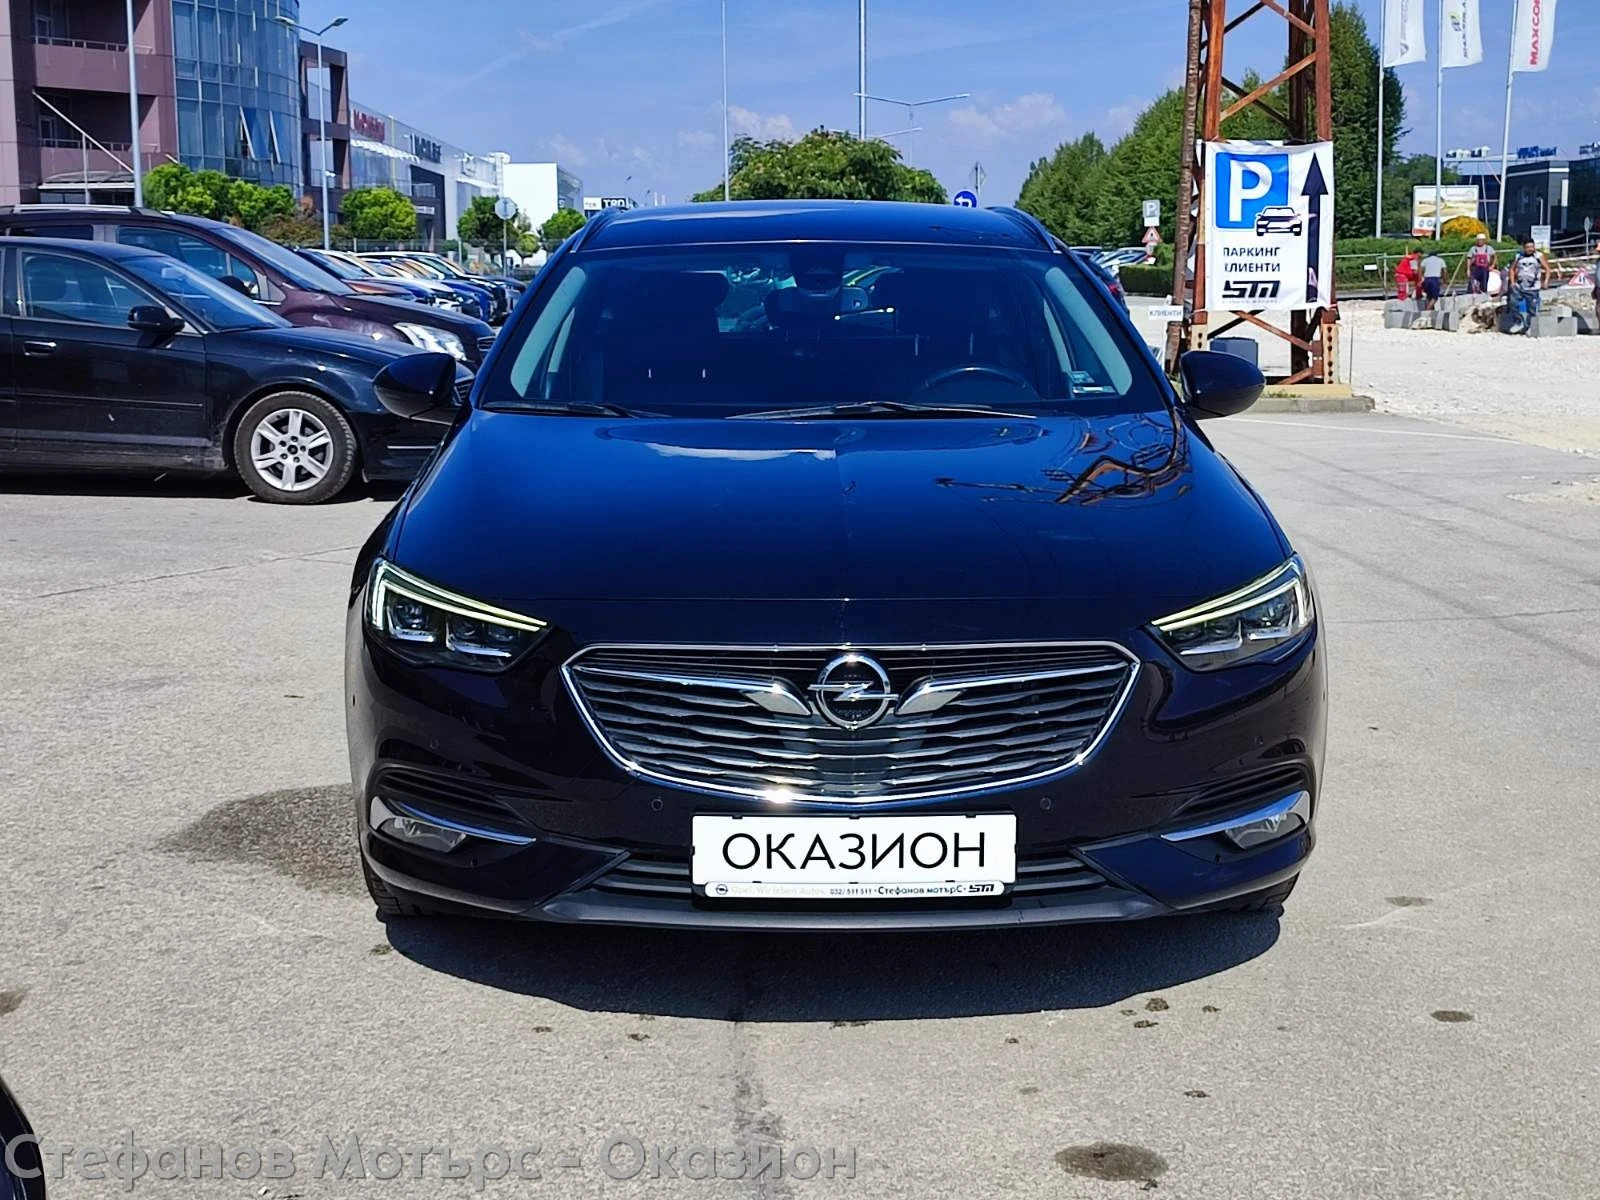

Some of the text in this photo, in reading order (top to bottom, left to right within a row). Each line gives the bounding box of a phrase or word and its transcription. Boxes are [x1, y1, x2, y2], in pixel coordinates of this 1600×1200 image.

[1530, 0, 1540, 65] MAXCO
[1229, 159, 1272, 222] P
[1223, 246, 1280, 257] ПАРКИНГ
[722, 832, 985, 870] ОКАЗИОН
